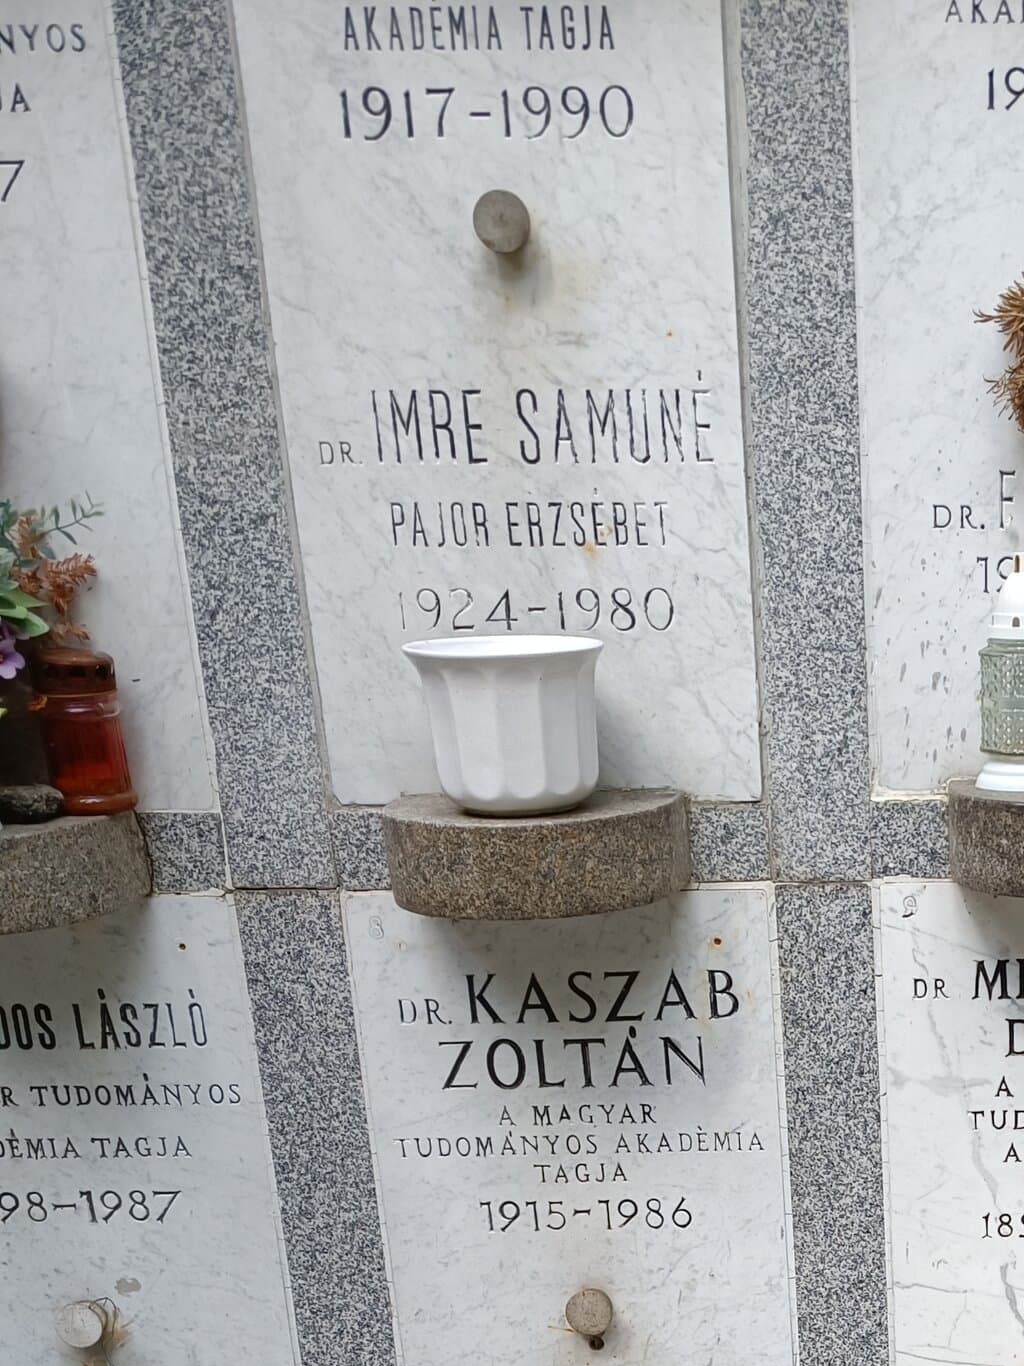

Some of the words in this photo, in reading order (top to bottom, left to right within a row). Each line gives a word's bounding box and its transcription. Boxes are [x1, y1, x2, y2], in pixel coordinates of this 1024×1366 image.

[520, 5, 615, 50] TAGJA
[339, 85, 634, 141] 1917-1990
[318, 440, 364, 466] DR.
[371, 388, 488, 465] IMRE
[390, 500, 490, 548] PAJOR
[932, 503, 986, 530] DR.
[398, 587, 675, 633] 1924-1980
[398, 997, 453, 1025] DR.
[464, 968, 741, 1026] KASZAB
[994, 1075, 1015, 1098] A
[499, 1105, 517, 1126] A
[532, 1103, 658, 1127] MAGYAR
[90, 1135, 193, 1159] TAGJA
[533, 1162, 629, 1184] TAGJA
[479, 1196, 693, 1233] 1915-1986
